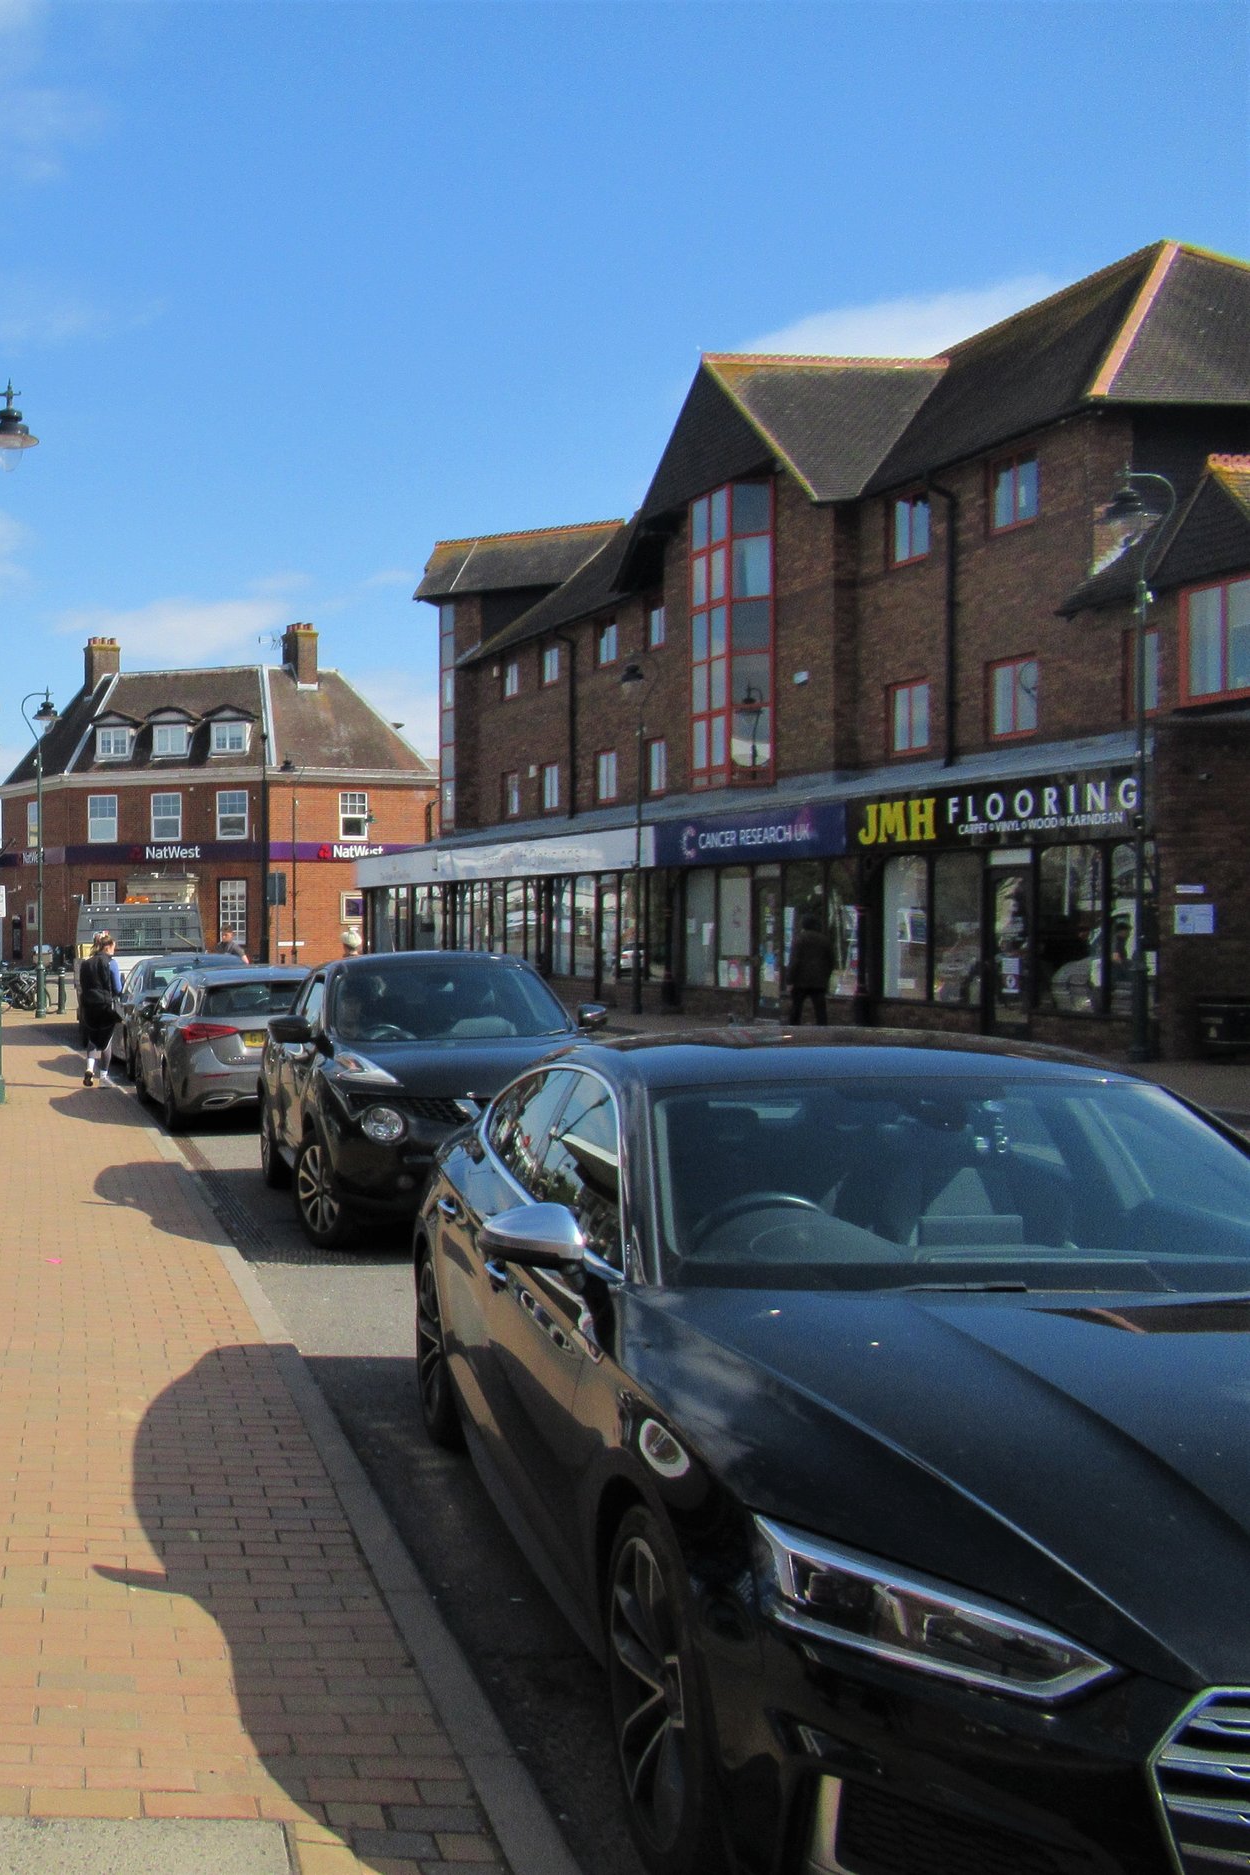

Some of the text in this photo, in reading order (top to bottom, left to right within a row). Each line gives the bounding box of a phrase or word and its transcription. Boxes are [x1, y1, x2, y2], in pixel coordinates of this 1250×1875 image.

[858, 777, 1139, 846] JMH FLOORING
[698, 830, 737, 850] CANCER
[739, 824, 792, 846] RESEARCH
[794, 823, 811, 842] UK
[958, 822, 989, 835] CARPET
[1027, 817, 1058, 830] WOOD
[145, 845, 201, 860] NatWest
